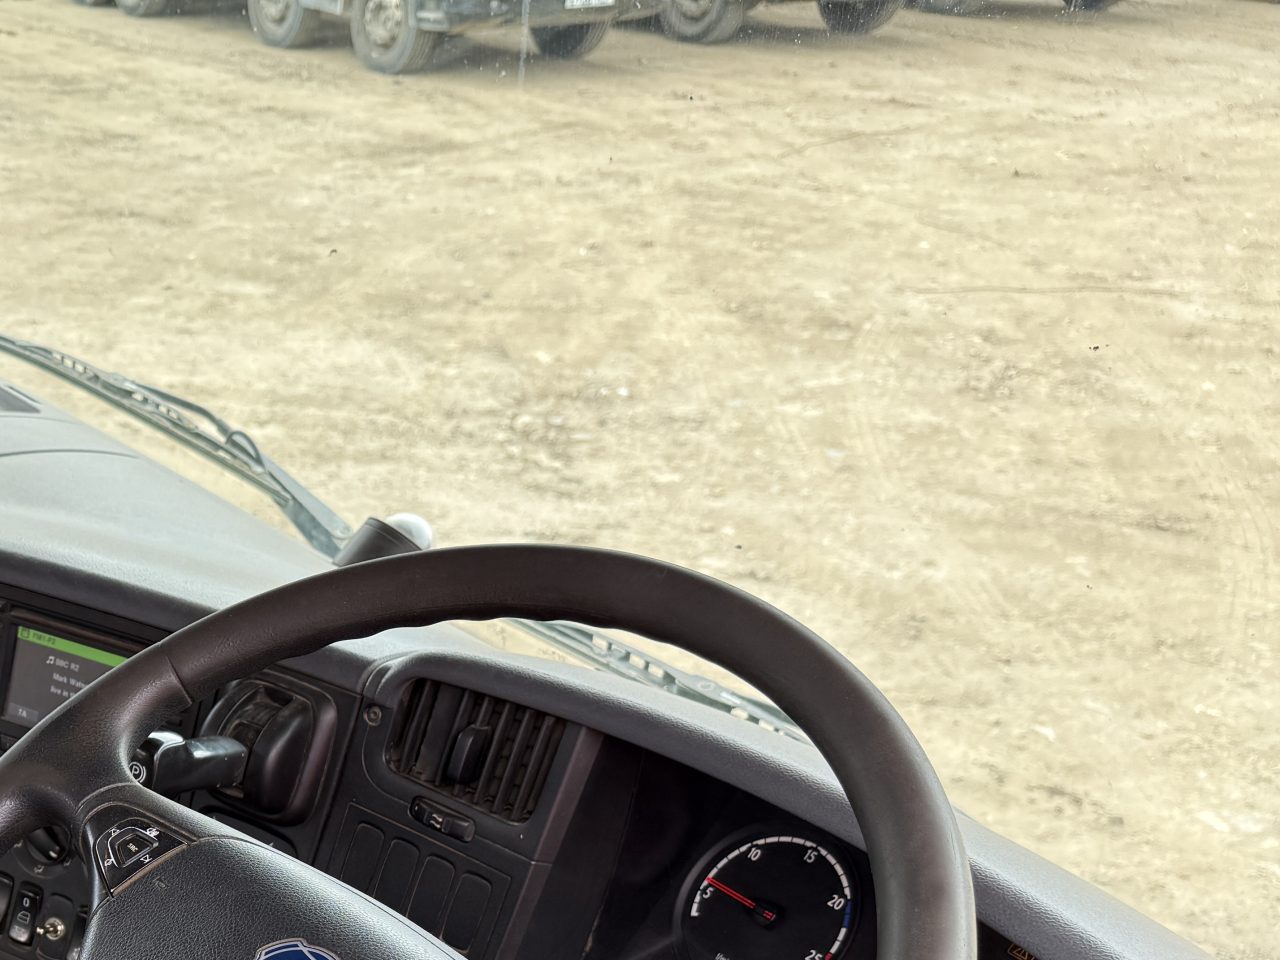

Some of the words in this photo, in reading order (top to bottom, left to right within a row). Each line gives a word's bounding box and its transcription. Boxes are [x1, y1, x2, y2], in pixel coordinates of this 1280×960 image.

[747, 847, 762, 861] 10
[803, 849, 818, 863] 15
[826, 894, 845, 910] 20
